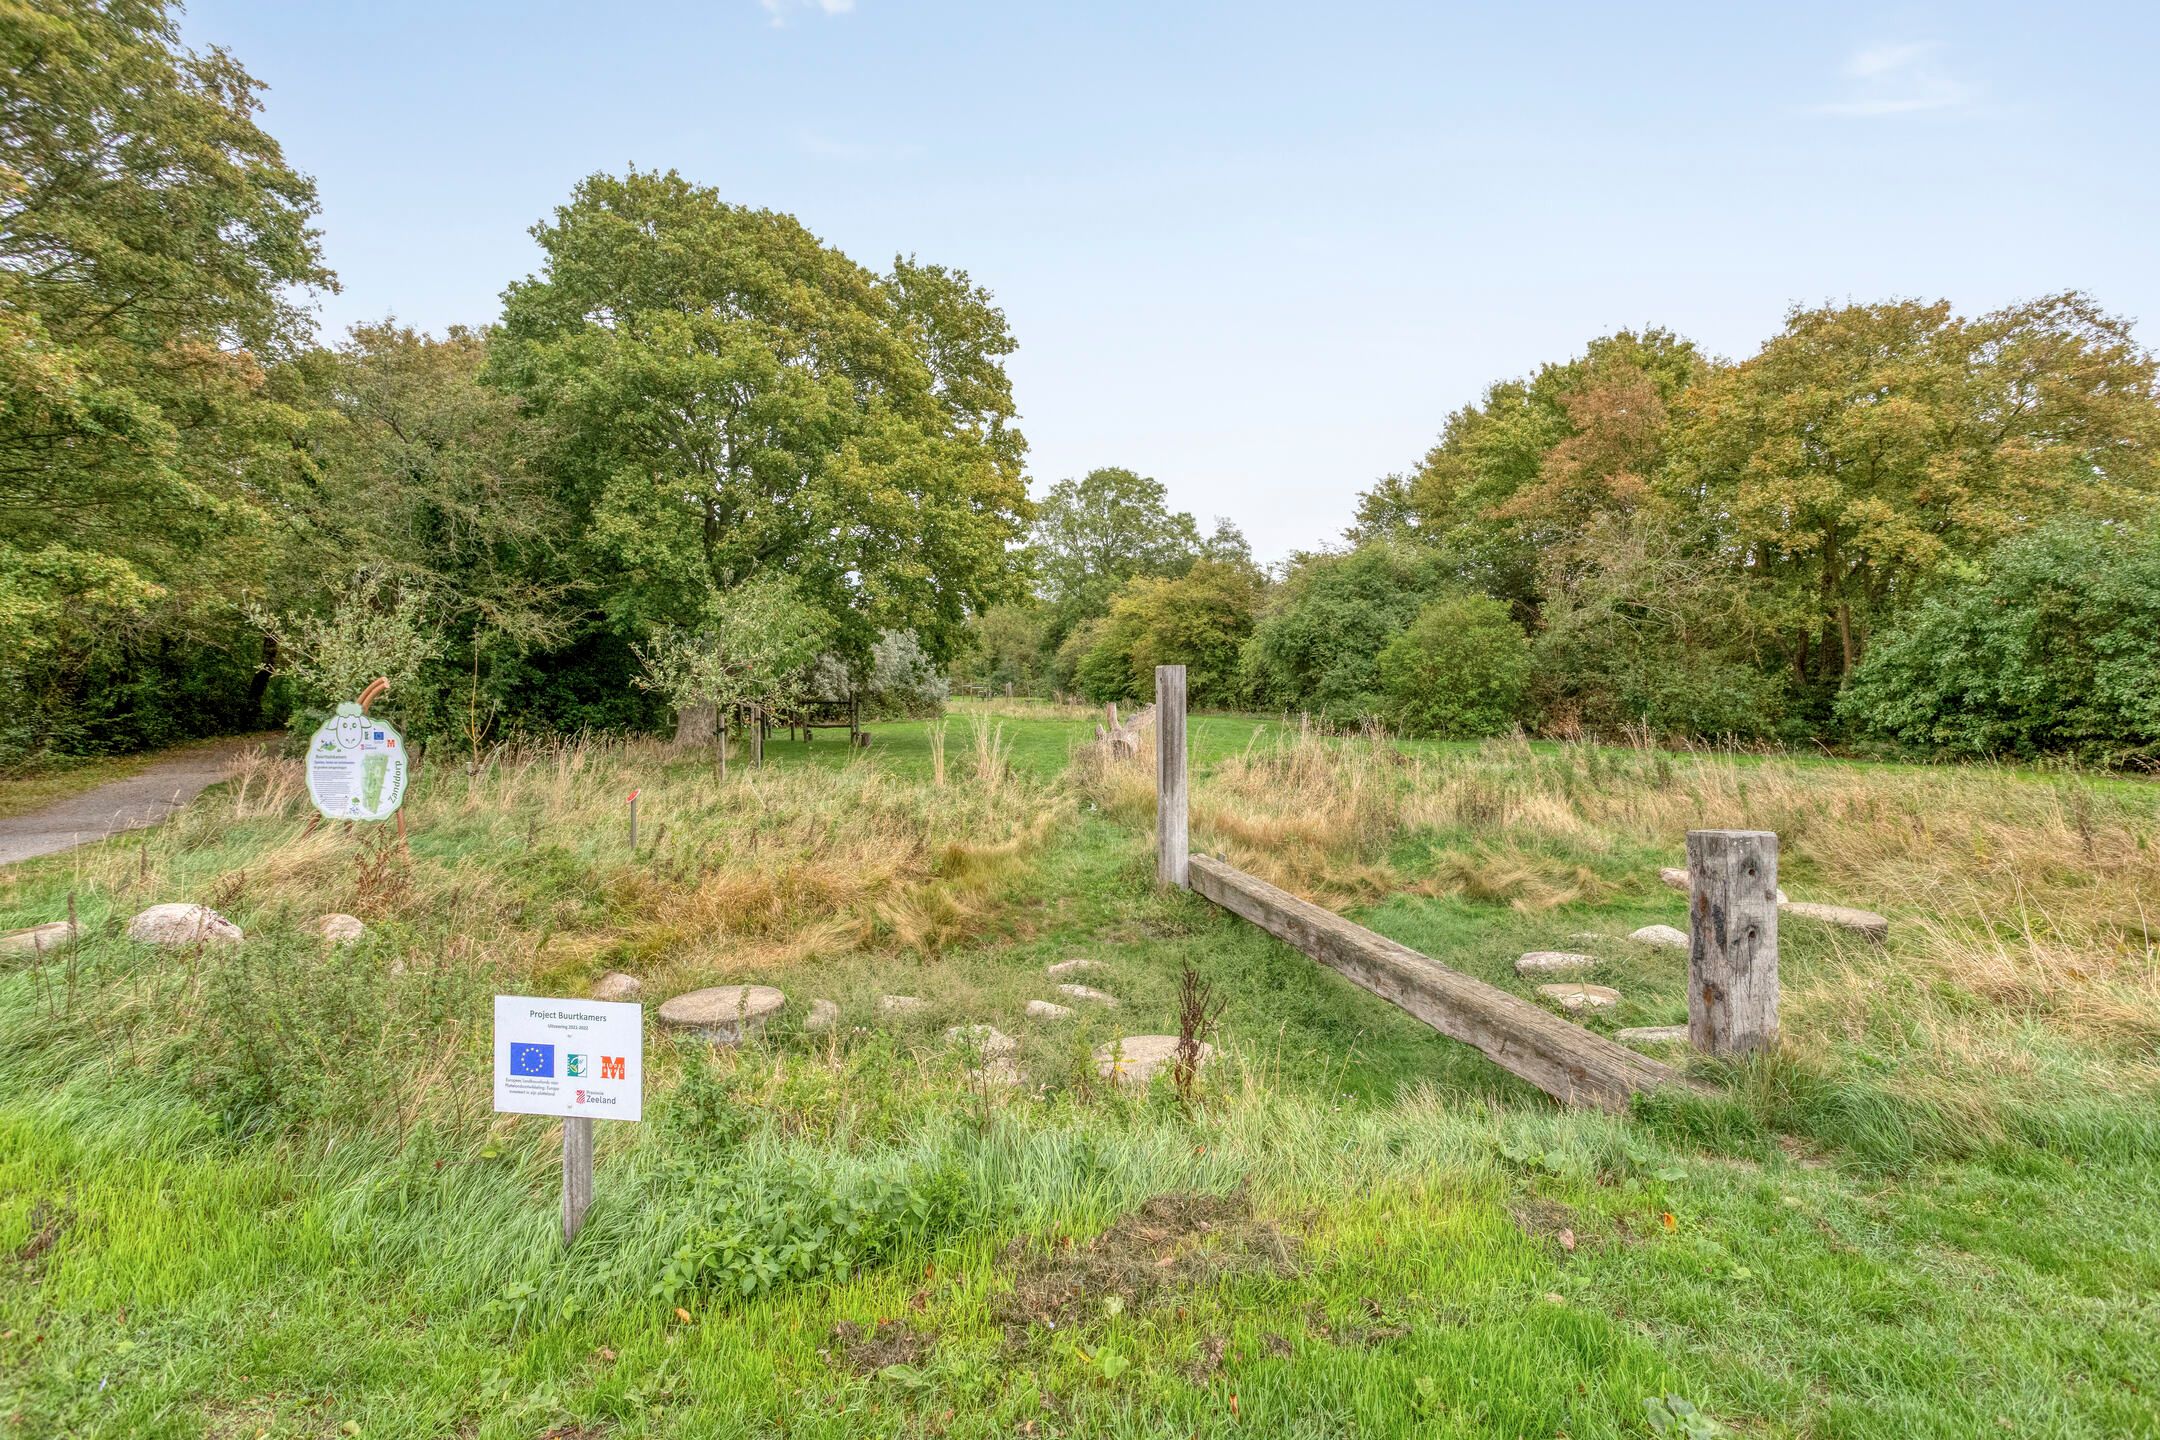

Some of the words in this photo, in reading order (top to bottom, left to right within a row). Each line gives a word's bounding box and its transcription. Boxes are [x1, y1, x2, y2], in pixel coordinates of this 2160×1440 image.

[388, 761, 403, 803] Zanddorp
[529, 1010, 556, 1020] Project
[558, 1011, 607, 1022] Buurtkamers
[586, 1095, 617, 1105] Zeeland
